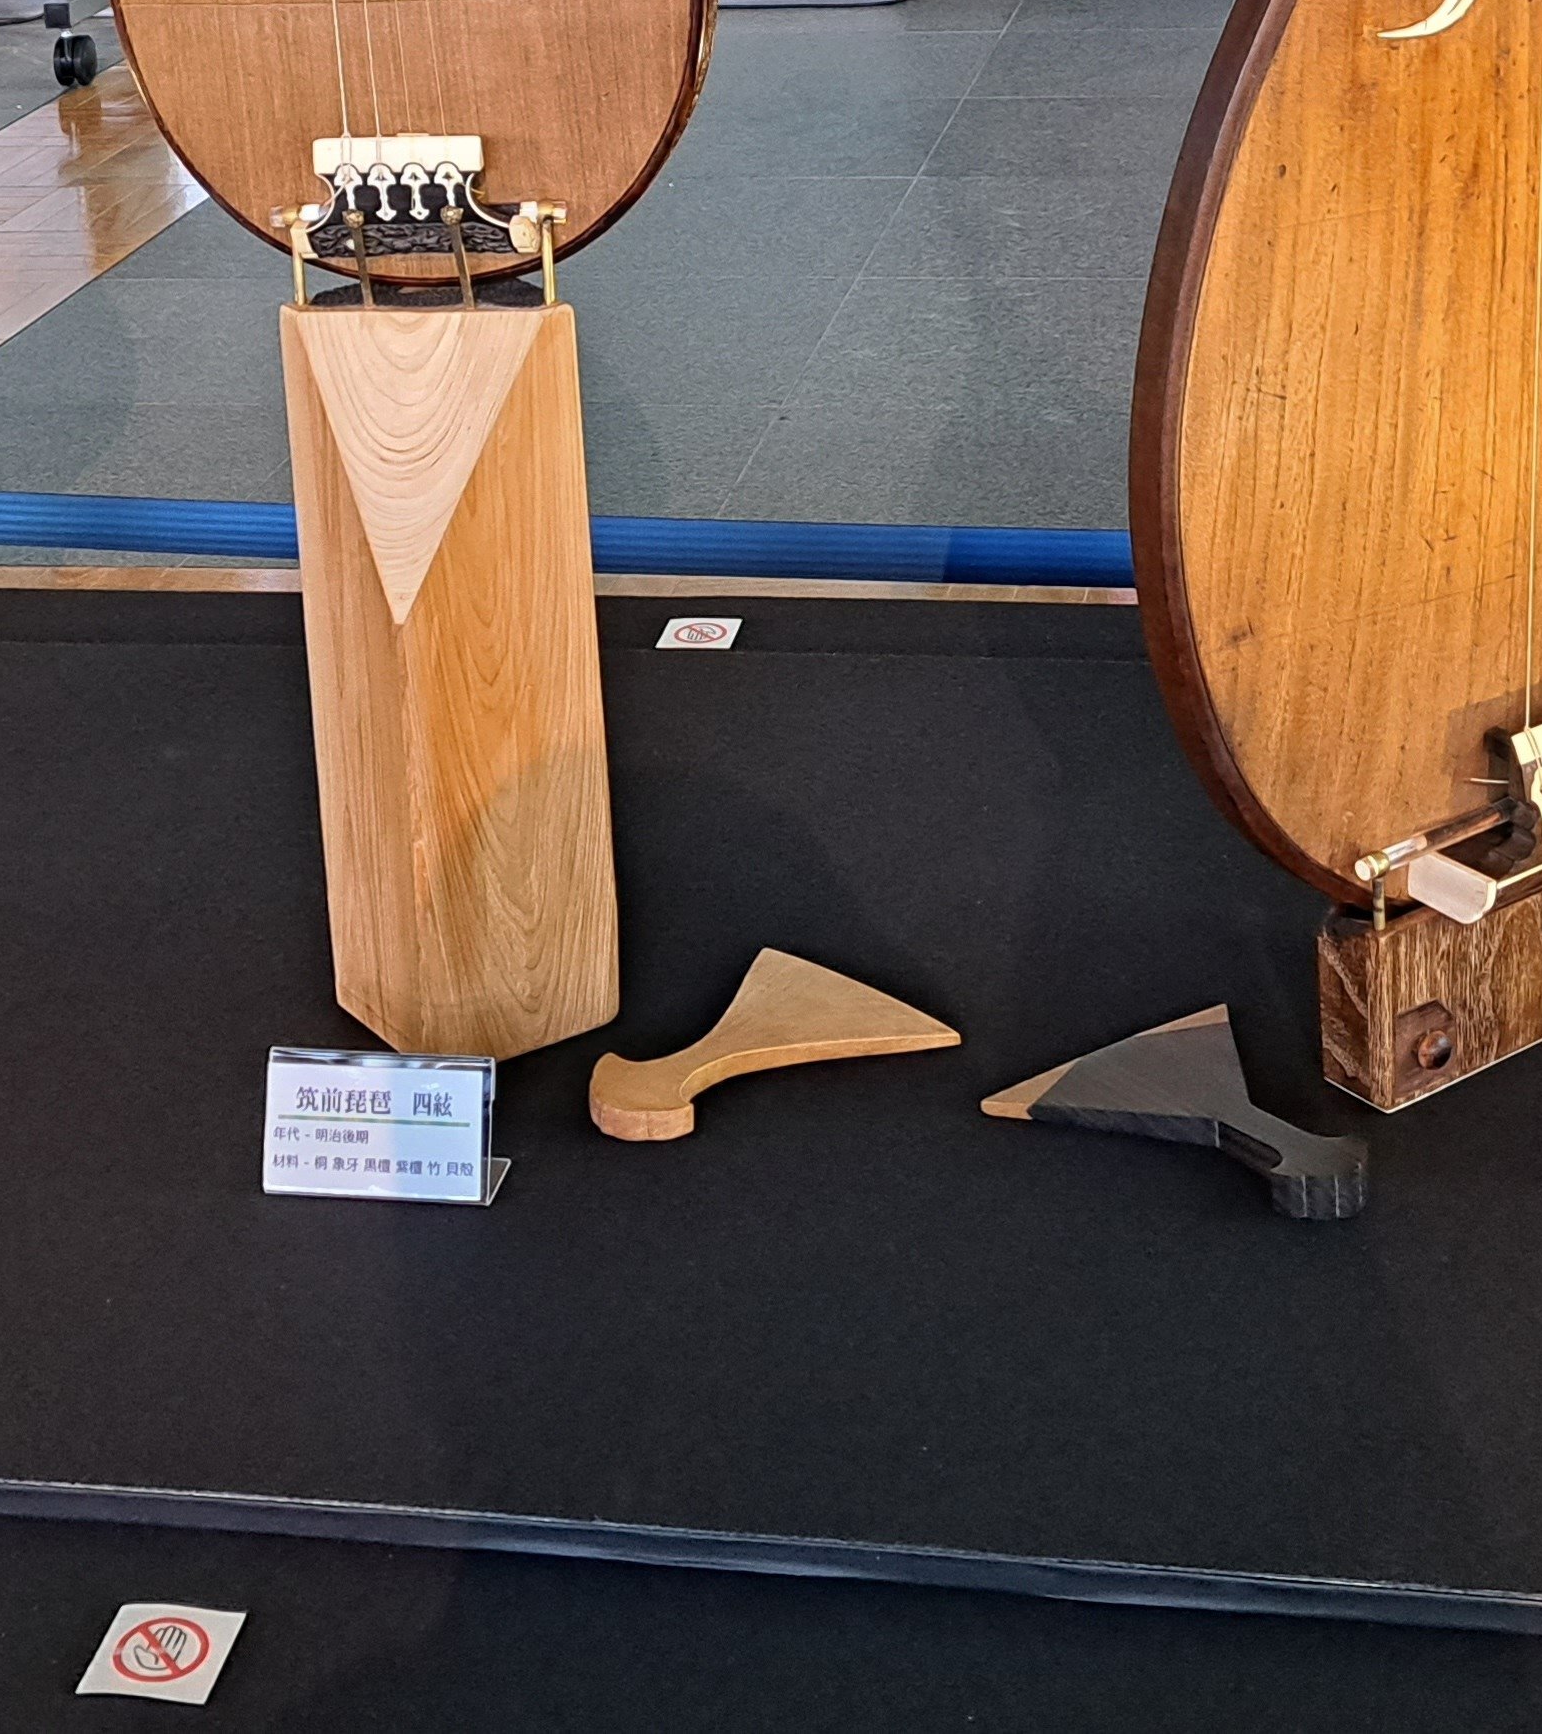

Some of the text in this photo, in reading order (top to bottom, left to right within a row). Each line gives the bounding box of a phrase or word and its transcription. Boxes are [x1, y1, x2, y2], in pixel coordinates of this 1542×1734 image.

[296, 1086, 392, 1115] 筑前琵琶
[273, 1126, 300, 1141] 年代
[315, 1128, 369, 1144] 明治後期
[427, 1161, 441, 1176] 竹
